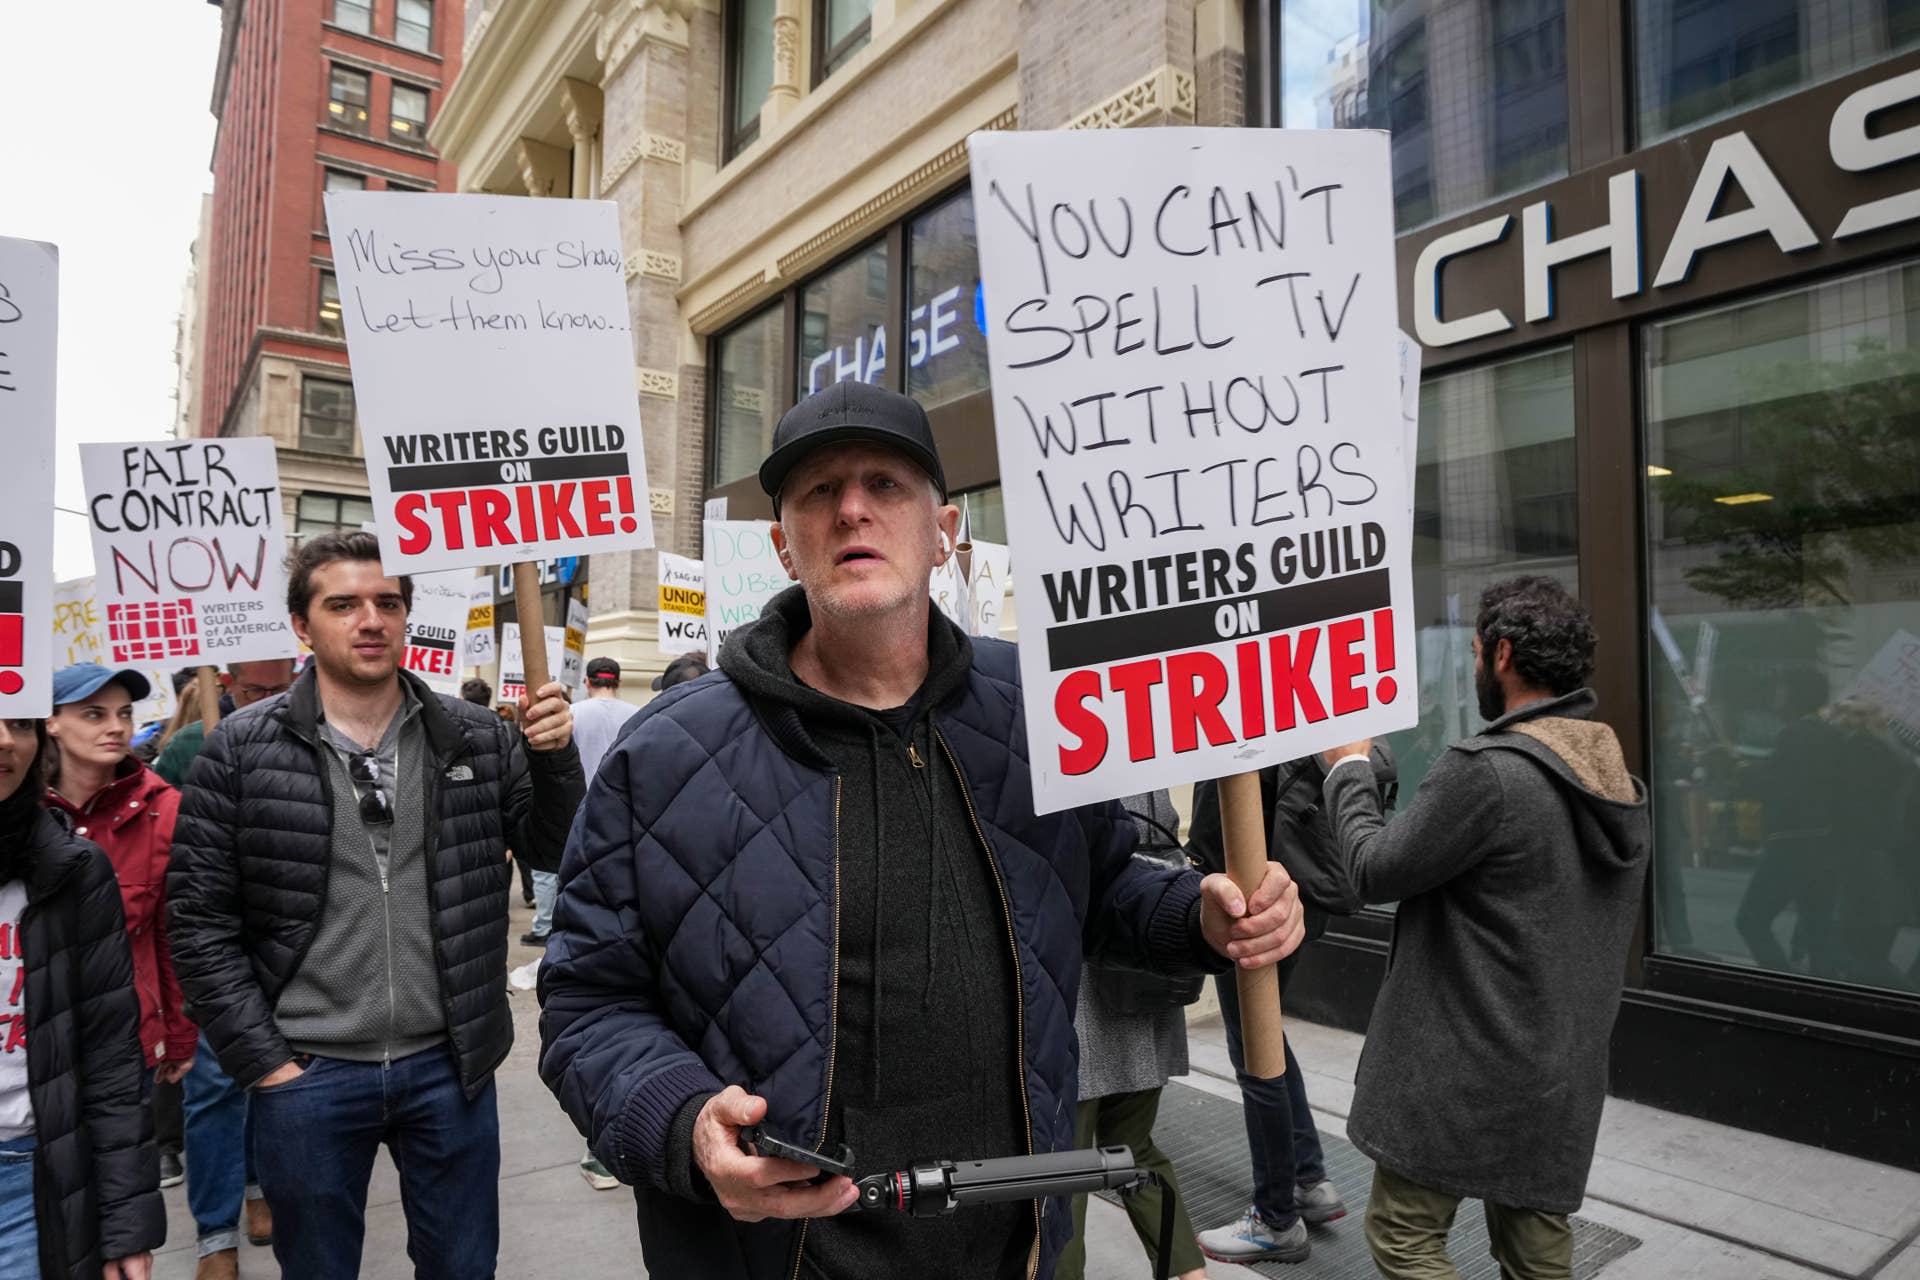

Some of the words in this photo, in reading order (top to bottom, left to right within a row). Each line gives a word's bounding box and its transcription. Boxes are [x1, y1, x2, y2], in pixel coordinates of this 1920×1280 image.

[1414, 69, 1920, 348] CHAS
[989, 179, 1134, 296] YOU
[1155, 165, 1343, 257] CAN'T
[348, 228, 465, 275] Miss
[469, 247, 548, 295] your
[440, 295, 528, 331] them
[1005, 283, 1235, 369] SPELL
[1013, 364, 1345, 459] WITHOUT
[383, 428, 529, 465] WRITERS
[537, 424, 625, 456] GUILD
[122, 444, 237, 488] FAIR
[500, 461, 532, 483] ON
[91, 486, 276, 533] CONTRACT
[394, 476, 638, 555] STRIKE!
[1036, 441, 1378, 551] WRITERS
[111, 534, 266, 597] NOW
[1041, 542, 1258, 623] WRITERS
[1270, 521, 1387, 586] GUILD
[202, 600, 264, 614] WRITERS
[663, 586, 706, 608] UNION
[203, 613, 247, 626] GUILD
[205, 626, 219, 637] of
[223, 621, 288, 636] AMERICA
[417, 624, 456, 640] GUILD
[665, 621, 708, 641] WGA
[1215, 599, 1261, 639] ON
[206, 636, 242, 649] EAST
[399, 645, 454, 675] IKE!
[1054, 607, 1398, 776] STRIKE!
